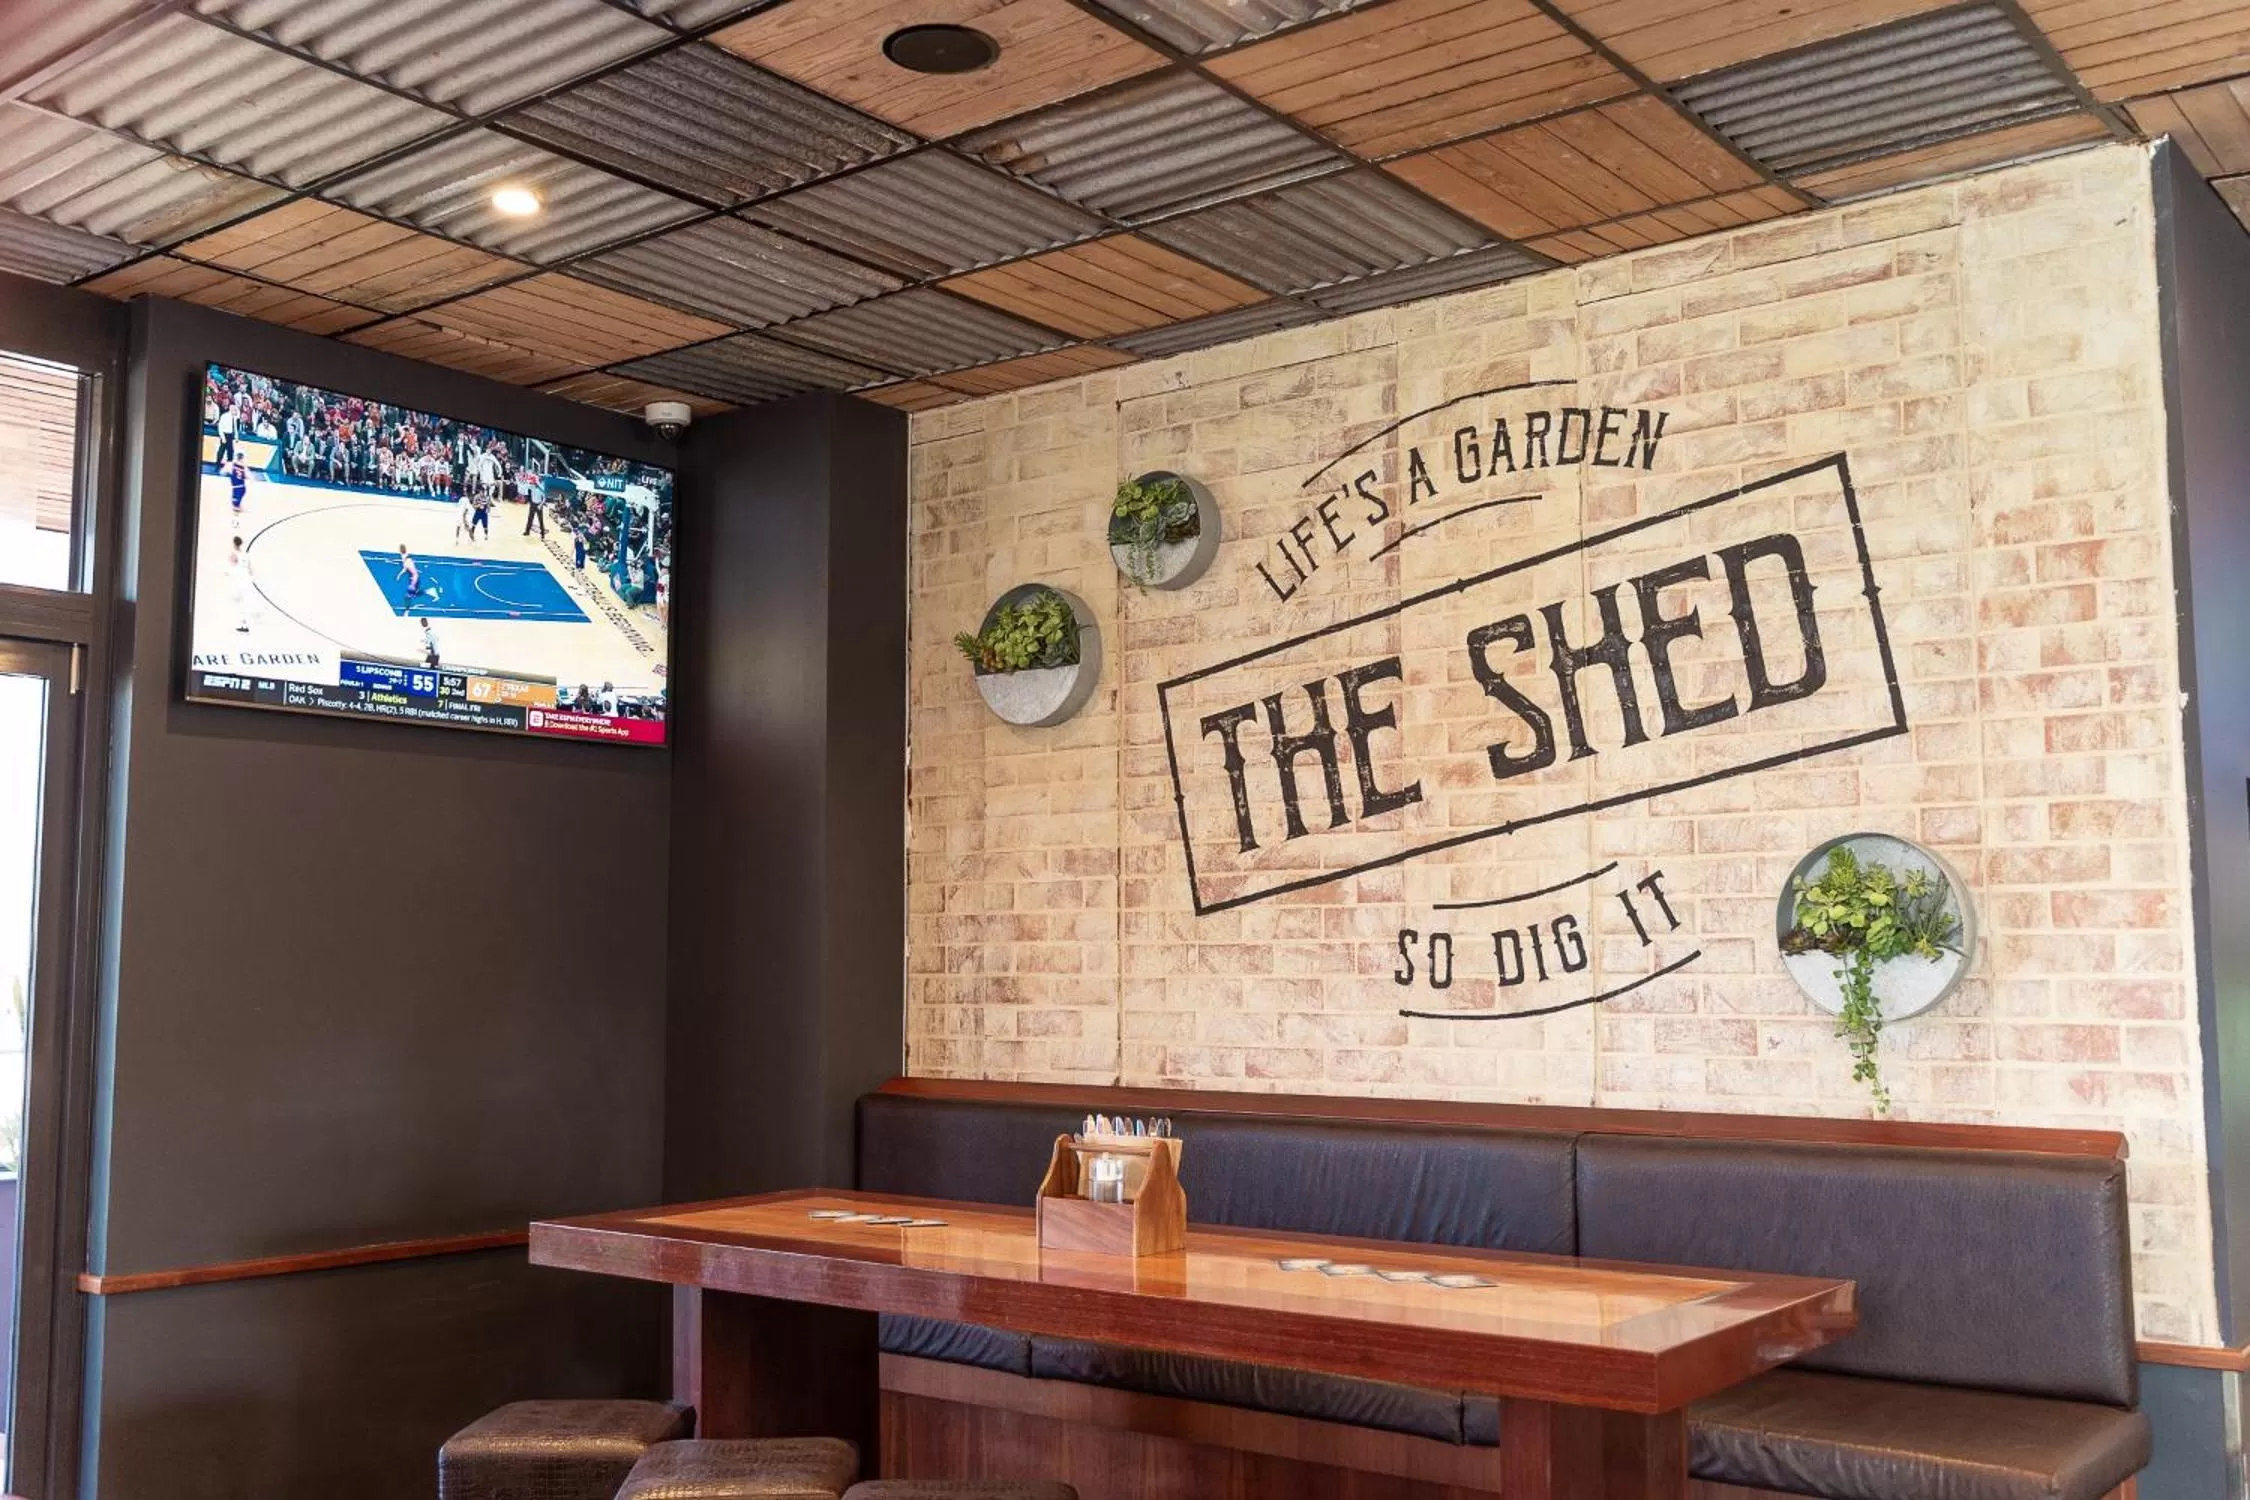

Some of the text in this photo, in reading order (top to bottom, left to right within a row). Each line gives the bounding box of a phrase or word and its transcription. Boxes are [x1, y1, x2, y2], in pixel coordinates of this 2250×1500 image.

[607, 477, 623, 489] NIT
[1256, 406, 1669, 603] LIFE'S A GARDEN
[240, 651, 320, 665] GARDEN
[361, 666, 403, 677] LIPSCOMB
[412, 674, 434, 692] 55
[288, 683, 323, 696] Red Sox
[358, 691, 365, 700] 3
[440, 686, 465, 697] 30 2nd
[473, 682, 491, 698] 67
[1200, 533, 1827, 854] THE SHED
[288, 694, 306, 705] OAK
[371, 692, 408, 705] Athletics
[437, 699, 444, 709] 7
[448, 702, 469, 712] FINAL
[598, 726, 617, 735] Sports
[618, 728, 630, 737] App
[1395, 870, 1683, 990] SO DIG IT
